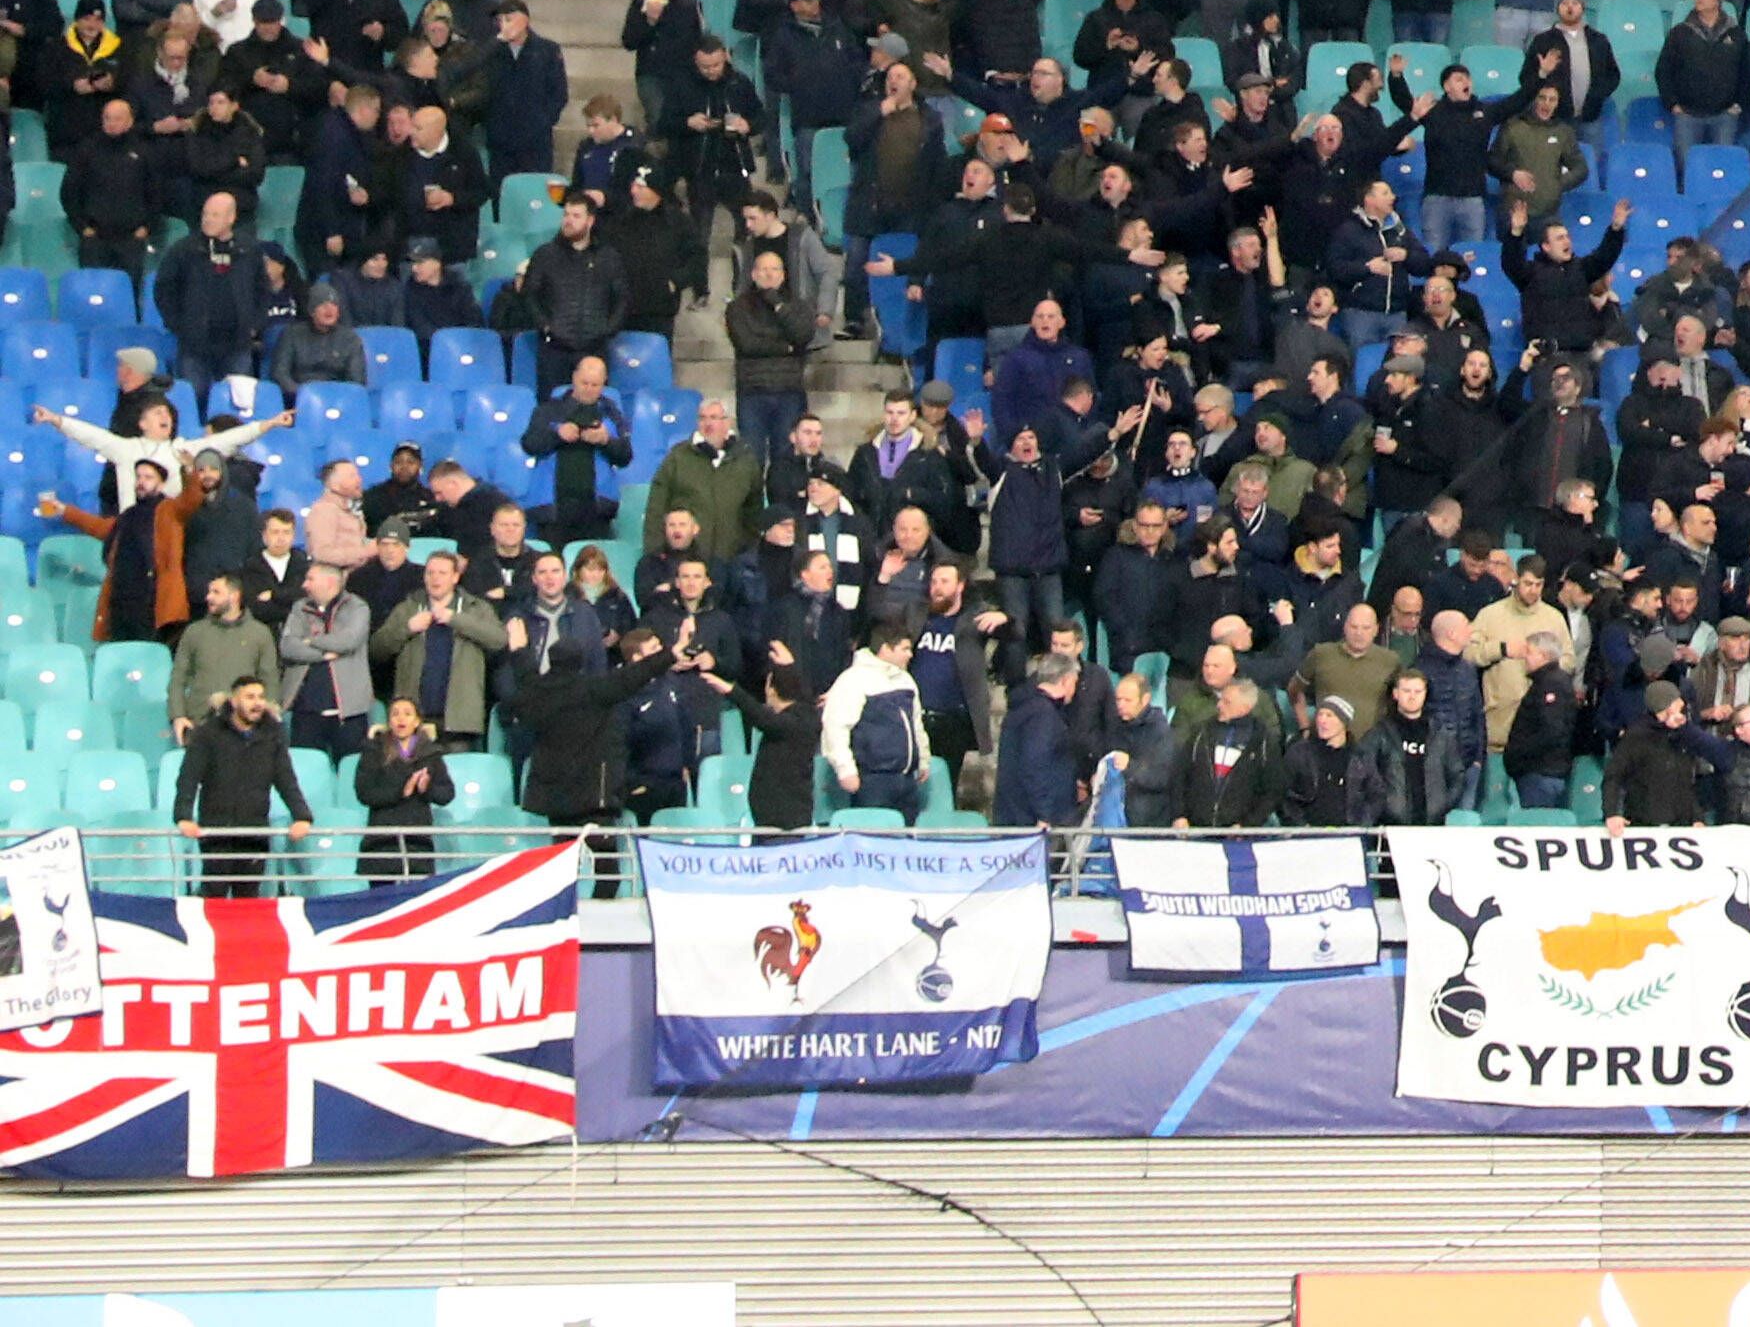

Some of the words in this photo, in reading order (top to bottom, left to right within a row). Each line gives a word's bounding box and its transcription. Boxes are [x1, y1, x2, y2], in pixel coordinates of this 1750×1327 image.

[917, 632, 956, 652] AIA
[659, 856, 702, 874] YOU
[710, 856, 768, 874] CAME
[777, 852, 845, 874] ALONG
[853, 850, 897, 872] JUST
[905, 854, 949, 874] LIKE
[959, 854, 973, 872] A
[981, 850, 1036, 871] SONG
[1493, 836, 1705, 872] SPURS
[1141, 891, 1199, 915] SOUTH
[1200, 895, 1295, 916] WOODHAM
[5, 996, 43, 1016] The
[46, 985, 92, 1007] Glory
[20, 956, 544, 1049] TTENHAM
[717, 1035, 795, 1060] WHITE
[802, 1033, 868, 1057] HART
[876, 1031, 941, 1057] LANE
[967, 1025, 1004, 1051] N17
[1477, 1042, 1734, 1086] CYPRUS
